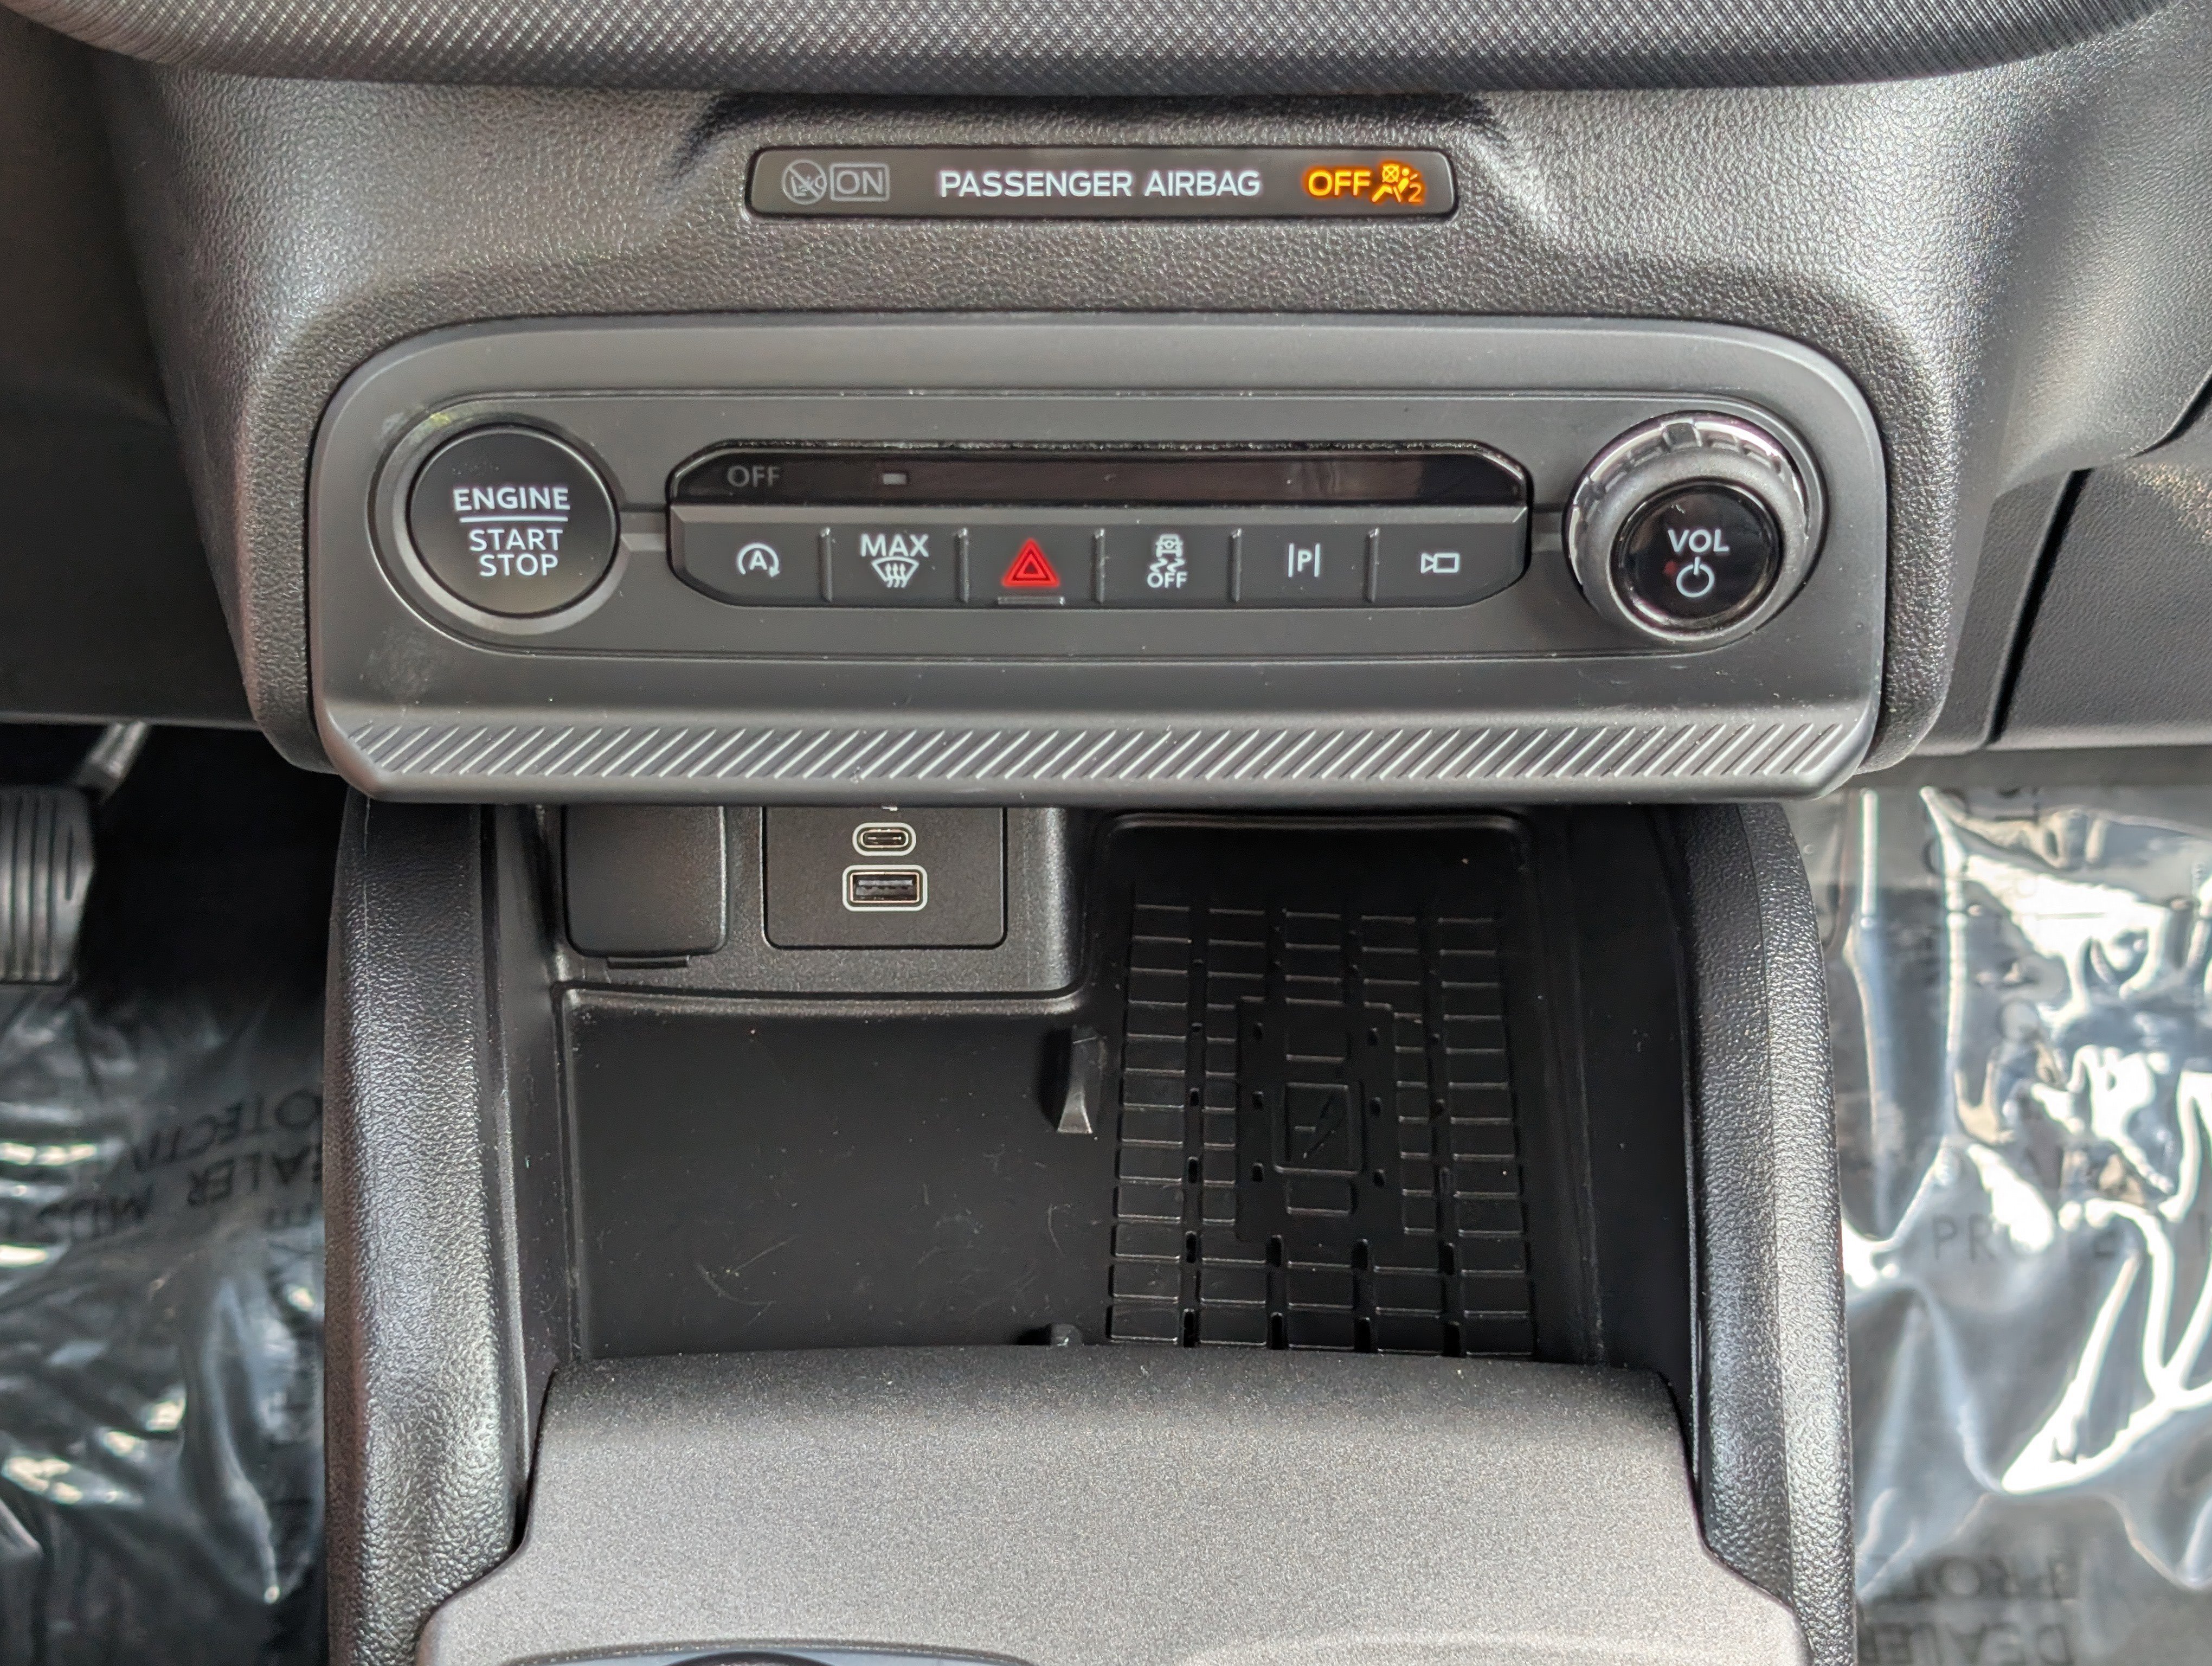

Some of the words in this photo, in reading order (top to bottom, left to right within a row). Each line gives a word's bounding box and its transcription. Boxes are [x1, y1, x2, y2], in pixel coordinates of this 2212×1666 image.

[836, 170, 883, 195] ON
[940, 170, 1132, 197] PASSENGER
[1144, 170, 1261, 196] AIRBAG
[1308, 169, 1371, 196] OFF
[727, 465, 780, 488] OFF
[453, 487, 570, 511] ENGINE
[468, 528, 563, 552] START
[860, 534, 929, 557] MAX
[1668, 529, 1729, 553] VOL
[479, 553, 558, 577] STOP
[1147, 572, 1188, 588] OFF
